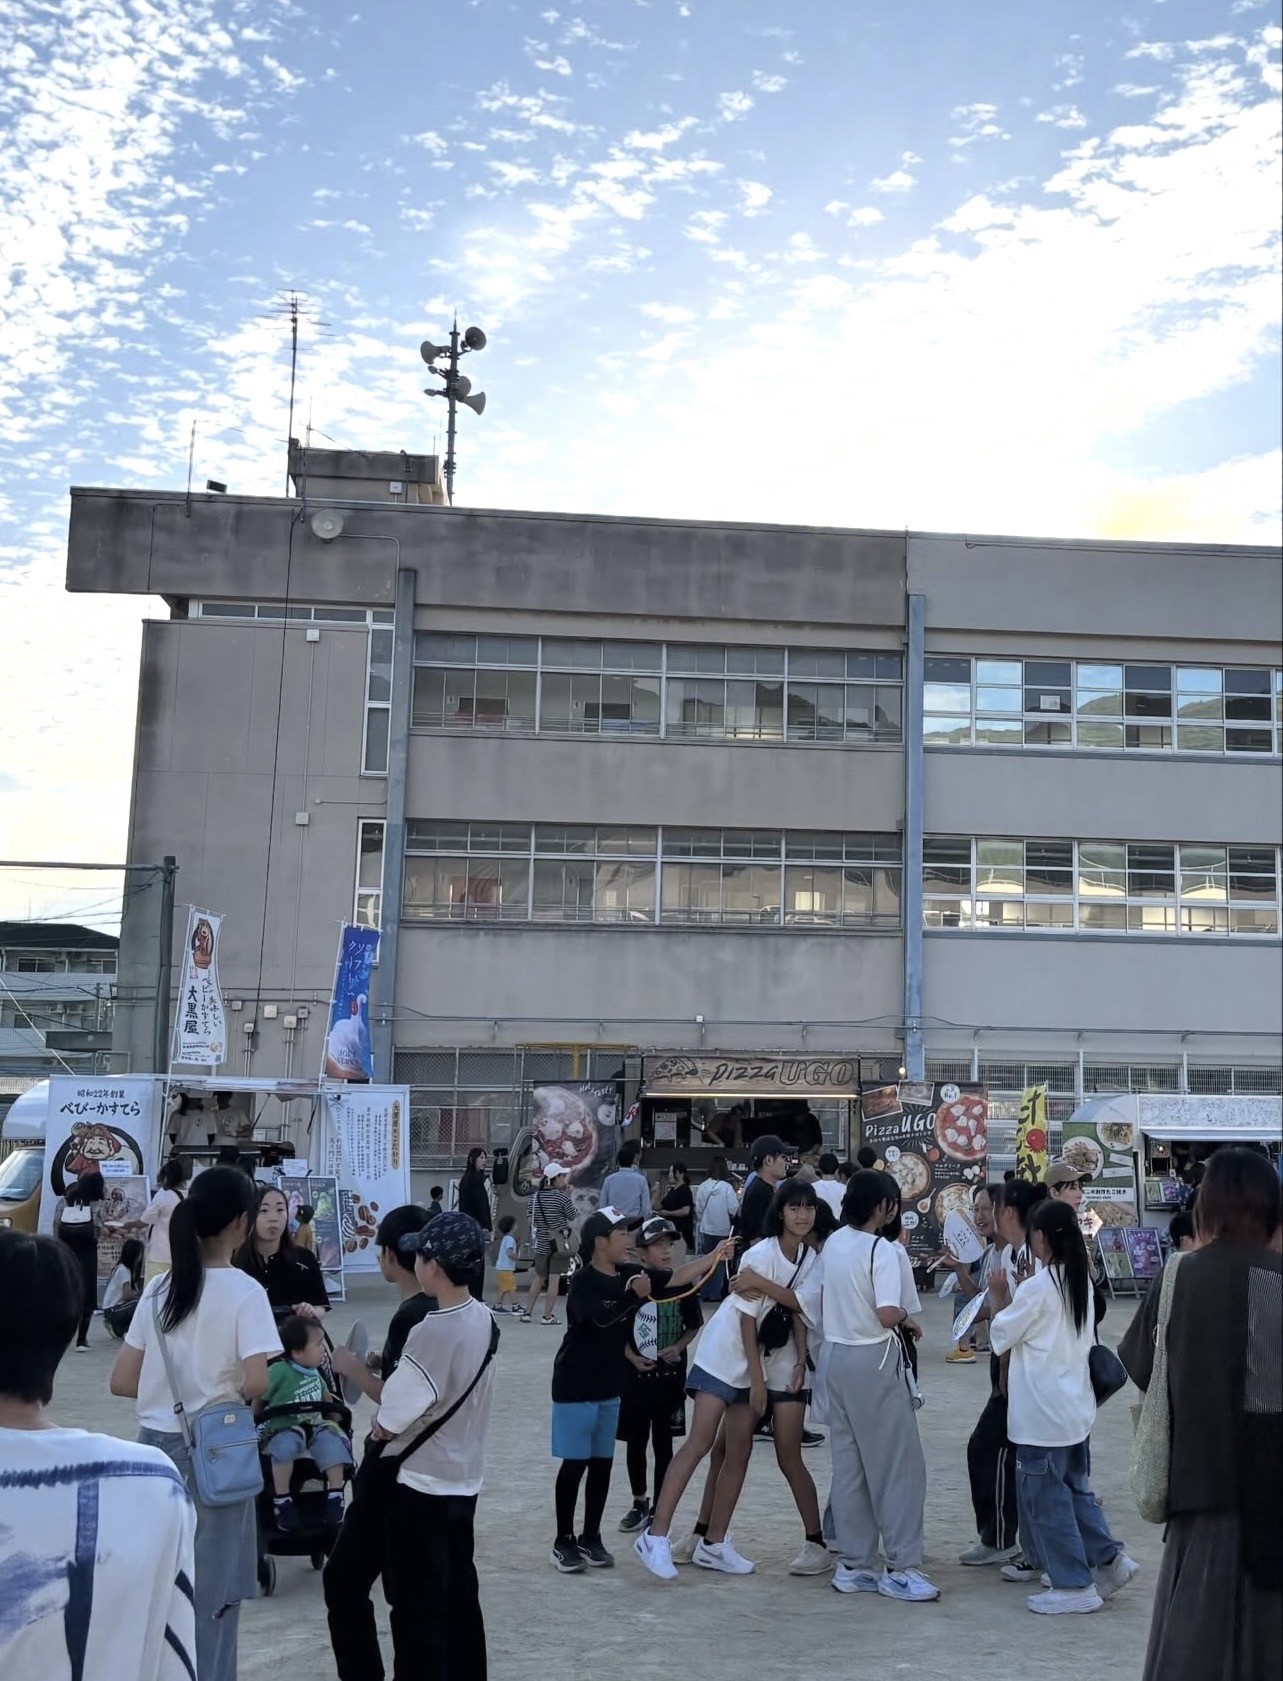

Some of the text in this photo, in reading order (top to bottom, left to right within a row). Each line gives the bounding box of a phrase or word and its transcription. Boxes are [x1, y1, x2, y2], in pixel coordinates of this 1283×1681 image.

[184, 985, 200, 1035] 大黒屋
[779, 1060, 855, 1086] UGO
[77, 1088, 126, 1099] 昭和22年創業
[60, 1101, 141, 1116] べびーかすてら
[901, 1113, 936, 1133] UGO
